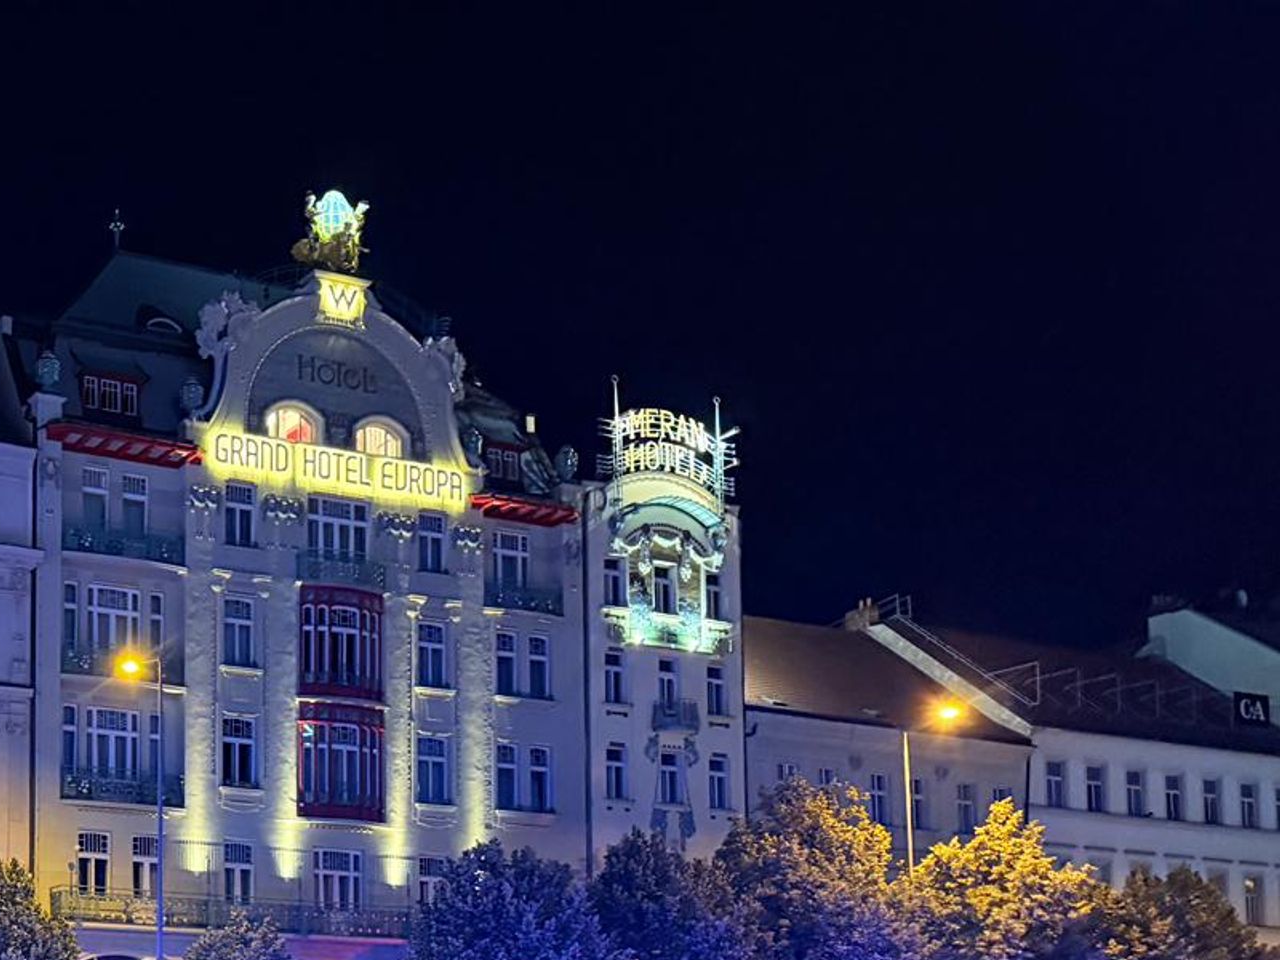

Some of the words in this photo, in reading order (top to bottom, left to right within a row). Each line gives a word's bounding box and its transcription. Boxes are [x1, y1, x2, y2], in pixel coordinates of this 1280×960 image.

[329, 284, 358, 310] W
[627, 408, 707, 453] MERAN
[214, 433, 289, 473] GRAND
[303, 447, 372, 487] HOTEL
[380, 459, 463, 502] EUROPA
[627, 440, 705, 486] HOTEL
